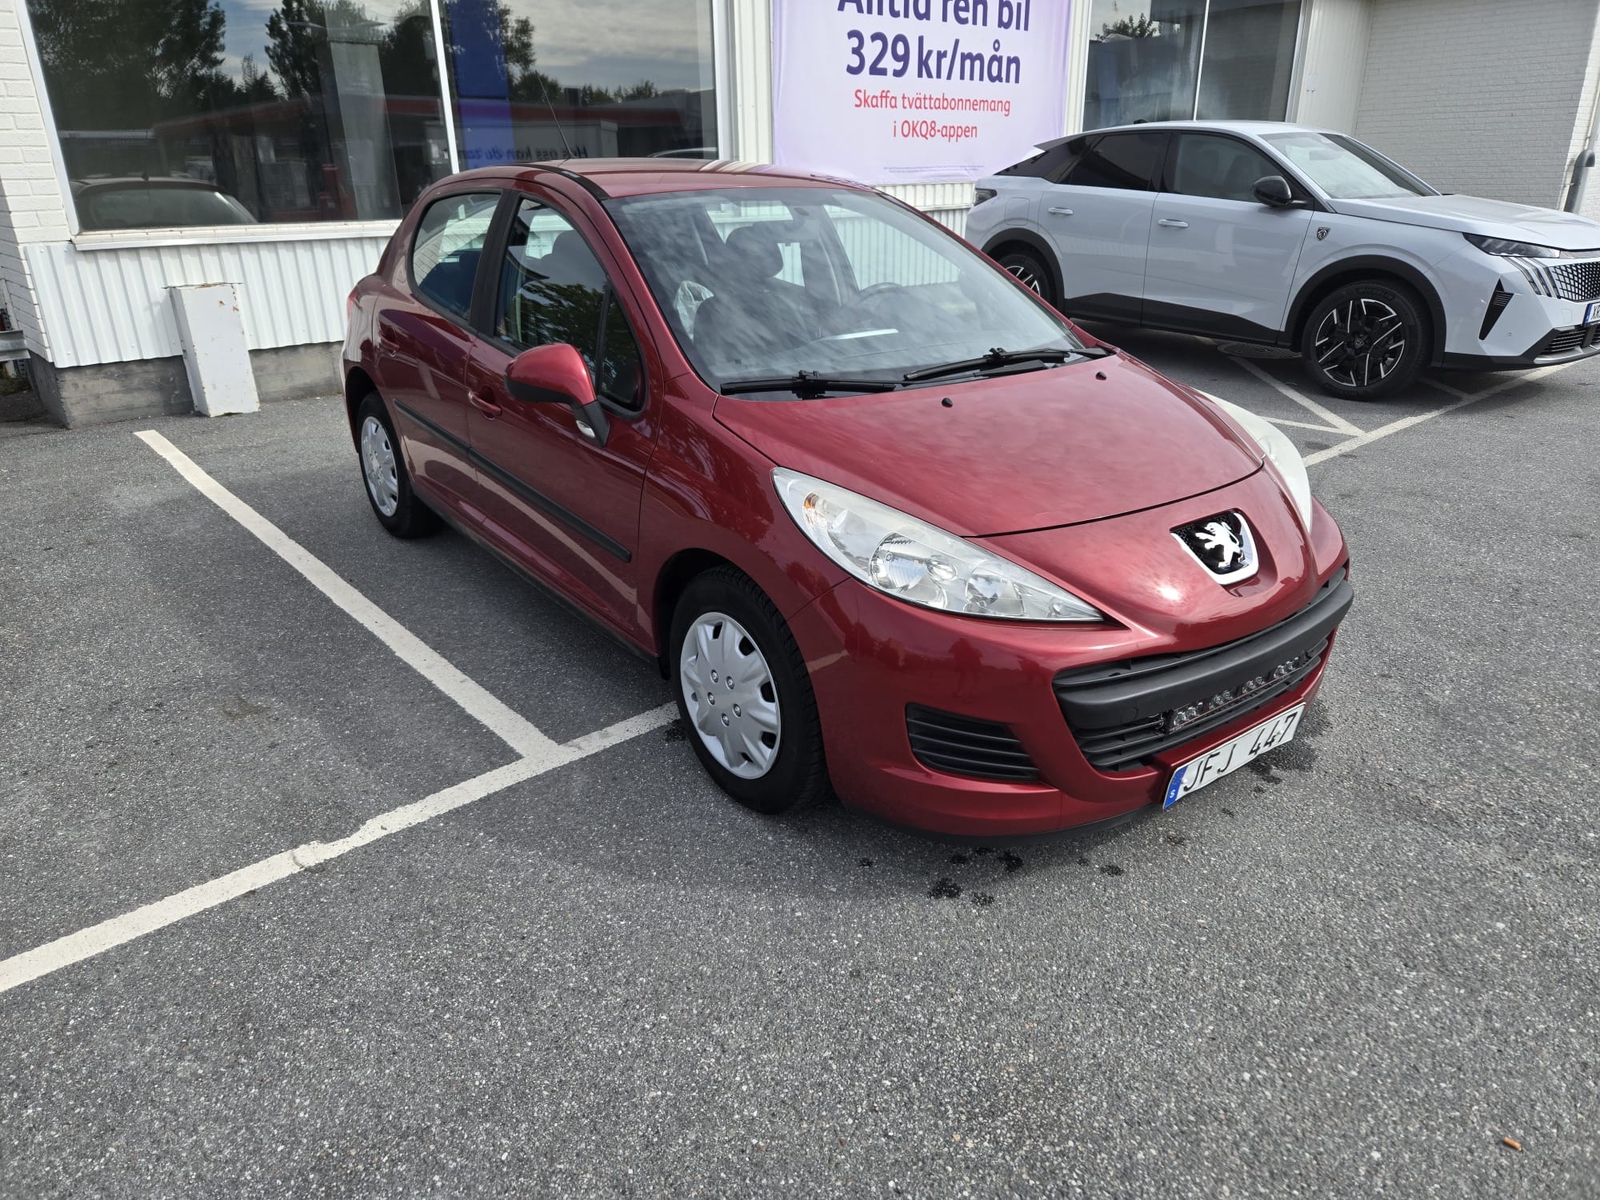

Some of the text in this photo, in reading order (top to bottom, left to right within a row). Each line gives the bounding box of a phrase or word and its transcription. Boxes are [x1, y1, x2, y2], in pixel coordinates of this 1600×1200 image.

[942, 0, 988, 27] ren
[998, 0, 1030, 31] bil
[846, 29, 1021, 84] 329 kr/mån
[854, 89, 1011, 117] Skaffa tvättabonnemang
[893, 119, 978, 142] i OKQ8-appen
[1183, 712, 1298, 792] JFJ 447
[1169, 789, 1176, 798] S
